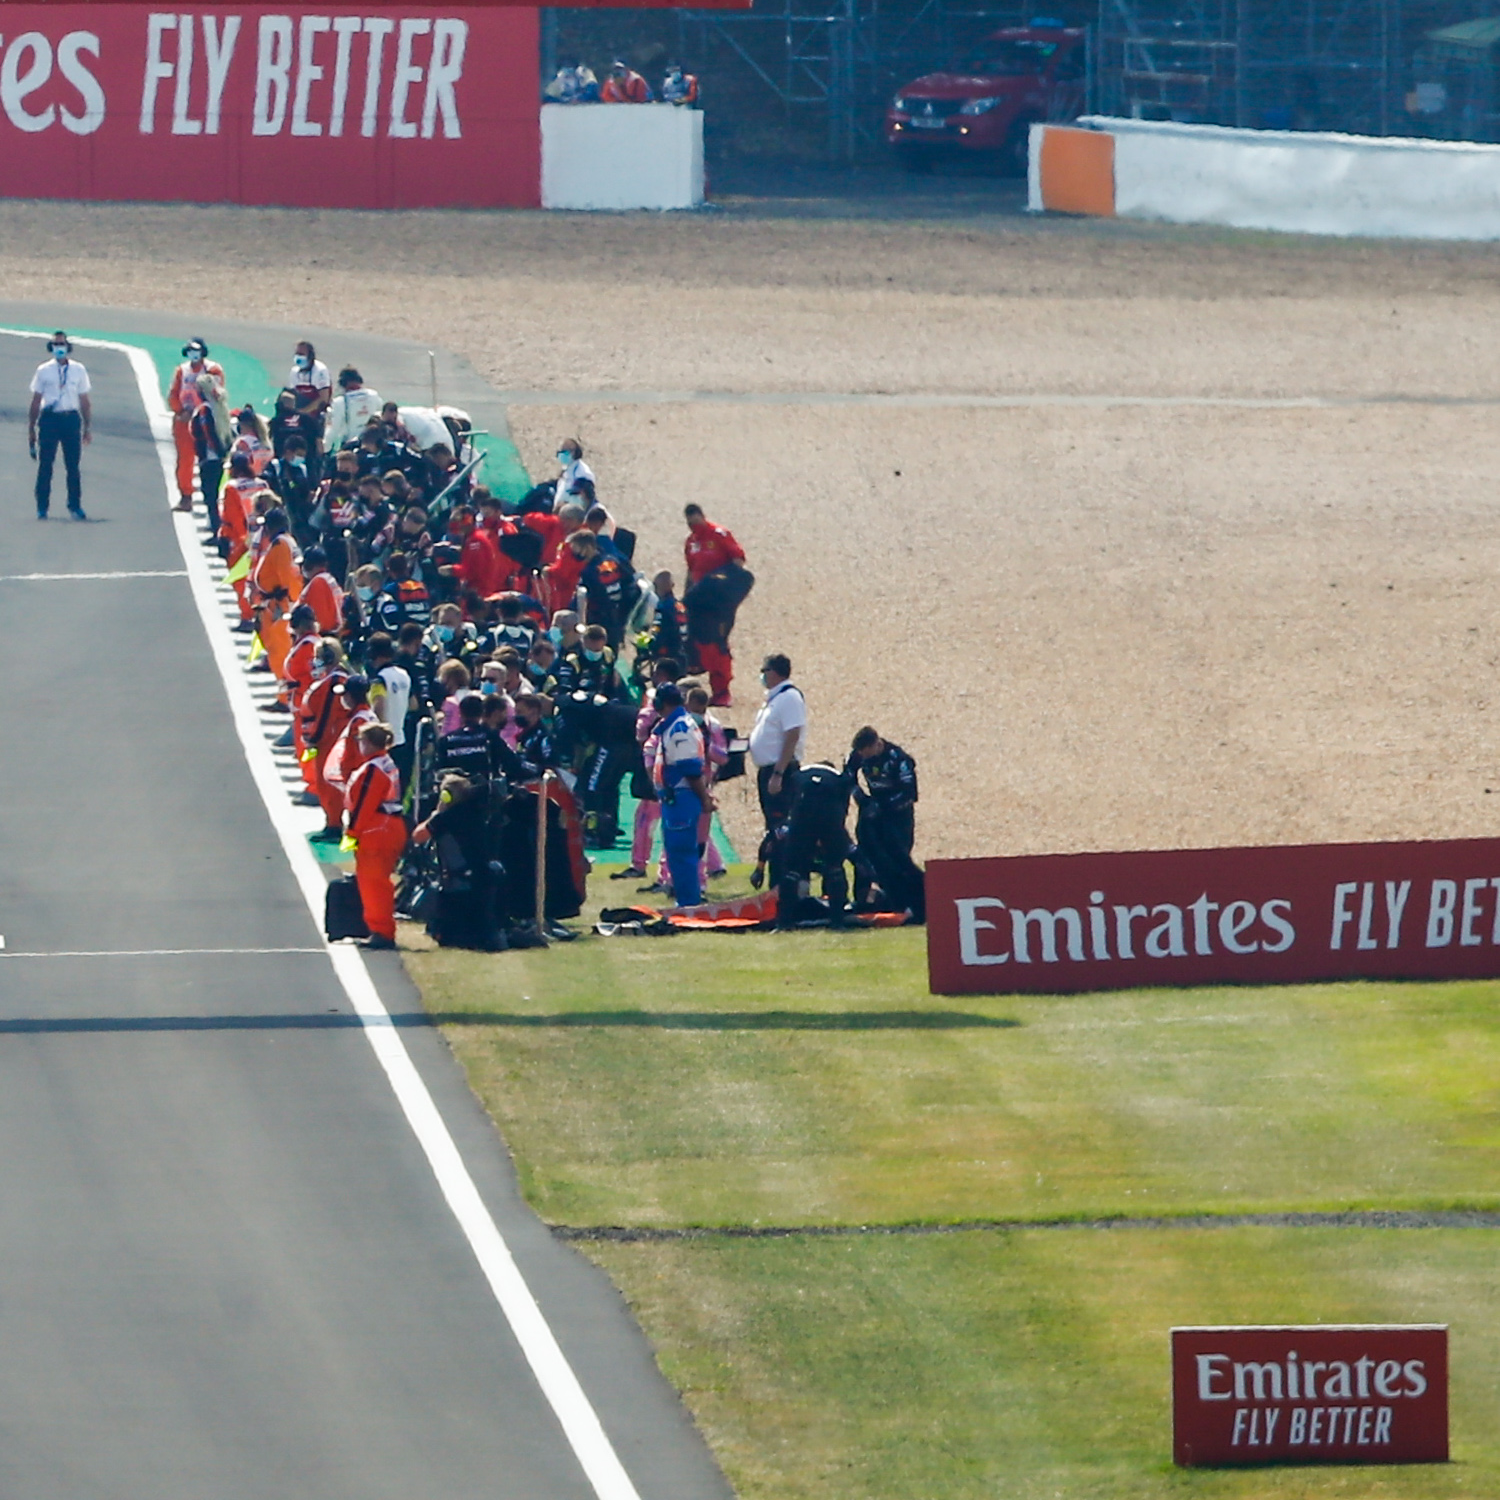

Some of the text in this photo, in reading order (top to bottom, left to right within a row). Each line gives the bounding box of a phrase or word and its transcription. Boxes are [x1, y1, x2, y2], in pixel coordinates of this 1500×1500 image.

[138, 12, 242, 136] FLY
[251, 15, 470, 140] BETTER
[954, 890, 1296, 967] Emirates
[1329, 879, 1412, 950] FLY
[1196, 1351, 1427, 1400] Emirates
[1232, 1405, 1392, 1446] FLY BETTER
